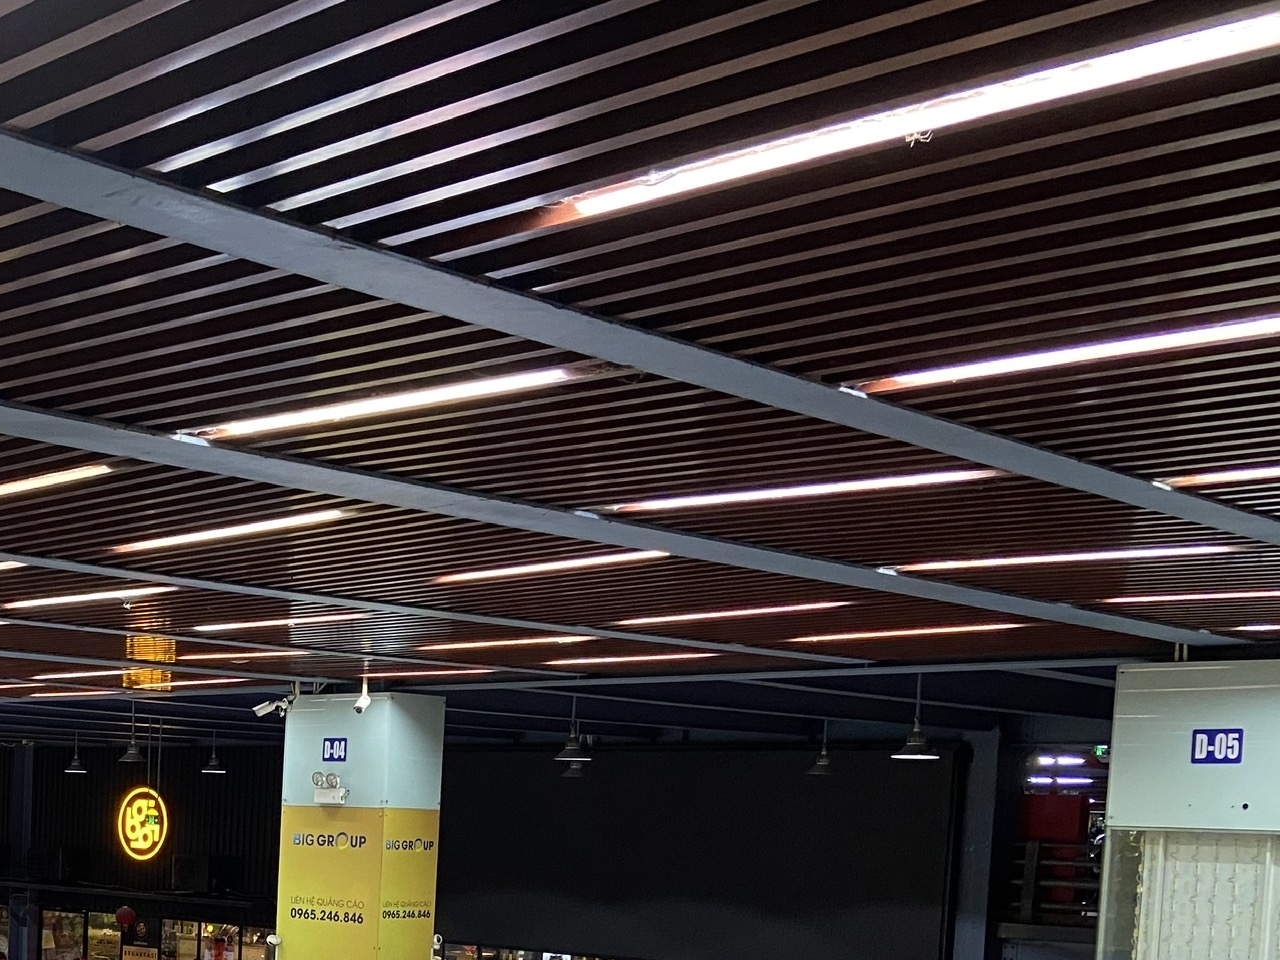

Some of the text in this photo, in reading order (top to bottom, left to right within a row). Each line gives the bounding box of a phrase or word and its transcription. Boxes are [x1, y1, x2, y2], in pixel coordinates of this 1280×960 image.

[324, 741, 346, 759] D-04
[1194, 733, 1240, 760] D-05
[293, 832, 366, 850] BIG GROUP
[385, 838, 434, 852] BIG GROUP
[290, 908, 364, 924] 0965.246.846
[382, 910, 431, 919] 0965.246.846
